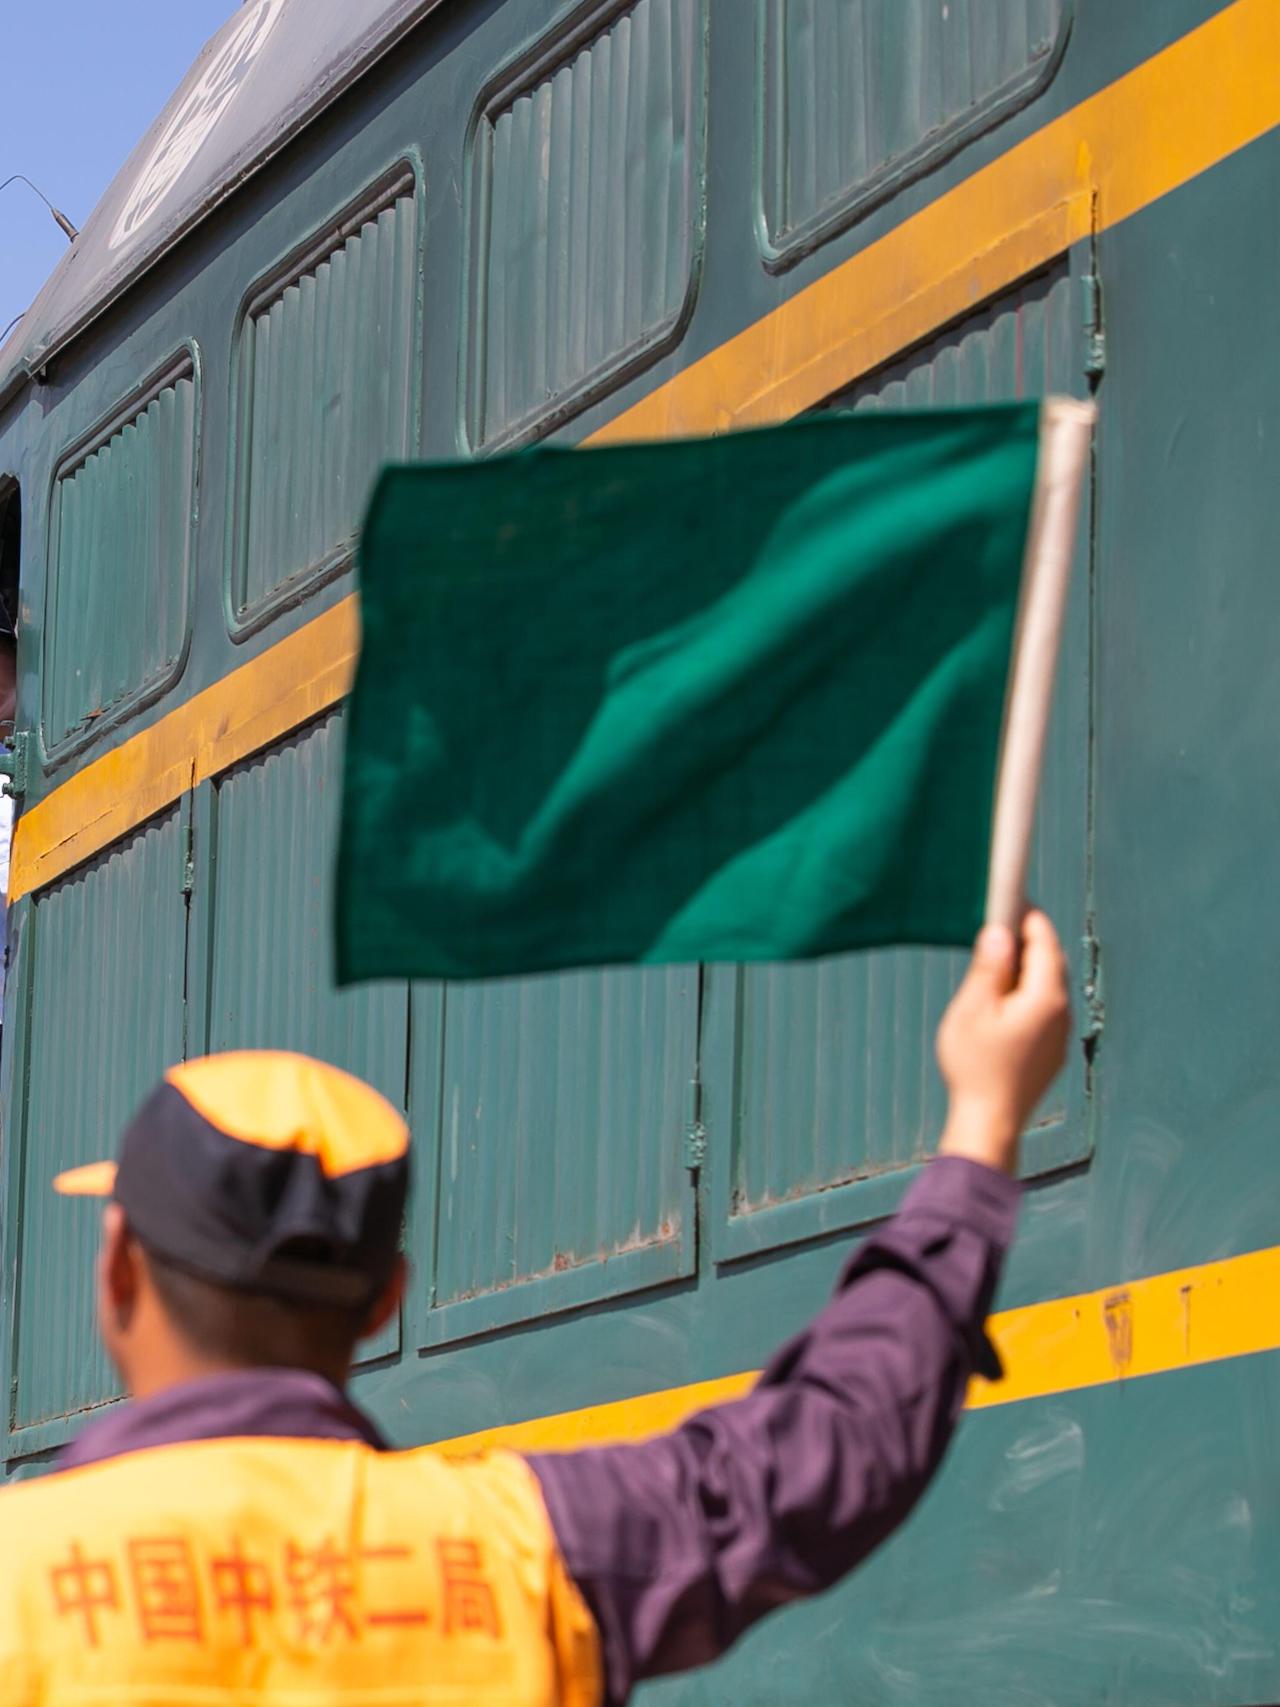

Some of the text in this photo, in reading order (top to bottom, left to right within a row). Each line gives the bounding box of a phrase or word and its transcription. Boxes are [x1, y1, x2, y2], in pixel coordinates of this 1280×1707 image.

[49, 1535, 503, 1648] 中国中铁二局
